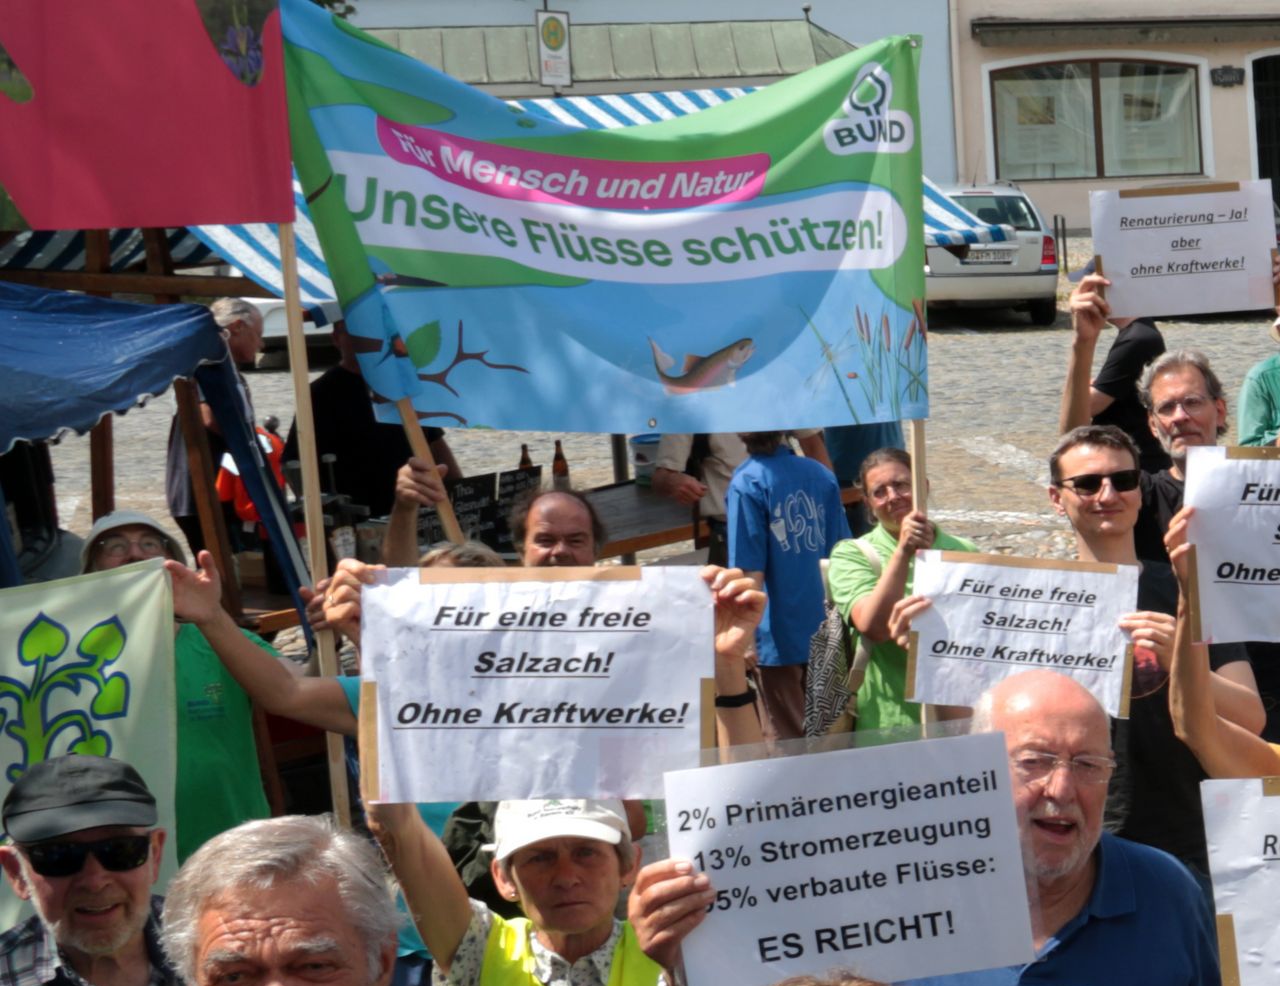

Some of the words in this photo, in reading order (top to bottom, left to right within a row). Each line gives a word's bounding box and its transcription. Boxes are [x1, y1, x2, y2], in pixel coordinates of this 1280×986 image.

[834, 119, 906, 148] BUND
[394, 129, 435, 170] Für
[440, 146, 588, 198] Mensch
[596, 174, 660, 200] und
[668, 169, 753, 199] Natur
[342, 174, 517, 243] Unsere
[527, 217, 673, 267] Flüsse
[681, 210, 885, 267] schützen!
[1120, 213, 1214, 227] Renaturierung
[1229, 208, 1248, 220] Ja!
[1171, 238, 1201, 248] aber
[1131, 263, 1163, 275] ohne
[1168, 256, 1245, 273] Kraftwerke!
[960, 579, 994, 594] Für
[1000, 584, 1043, 600] eine
[1050, 587, 1096, 604] freie
[433, 606, 490, 626] Für
[499, 607, 567, 627] eine
[578, 607, 651, 627] freie
[982, 612, 1071, 632] Salzach!
[474, 652, 615, 673] Salzach!
[932, 640, 985, 657] Ohne
[992, 646, 1116, 669] Kraftwerke!
[397, 702, 482, 725] Ohne
[493, 702, 689, 725] Kraftwerke!
[678, 807, 716, 832] 2%
[726, 770, 997, 826] Primärenergieanteil
[694, 846, 751, 871] 13%
[761, 816, 991, 863] Stromerzeugung
[706, 887, 757, 913] 5%
[766, 870, 887, 904] verbaute
[896, 857, 996, 885] Flüsse:
[758, 933, 804, 963] ES
[815, 910, 955, 954] REICHT!
